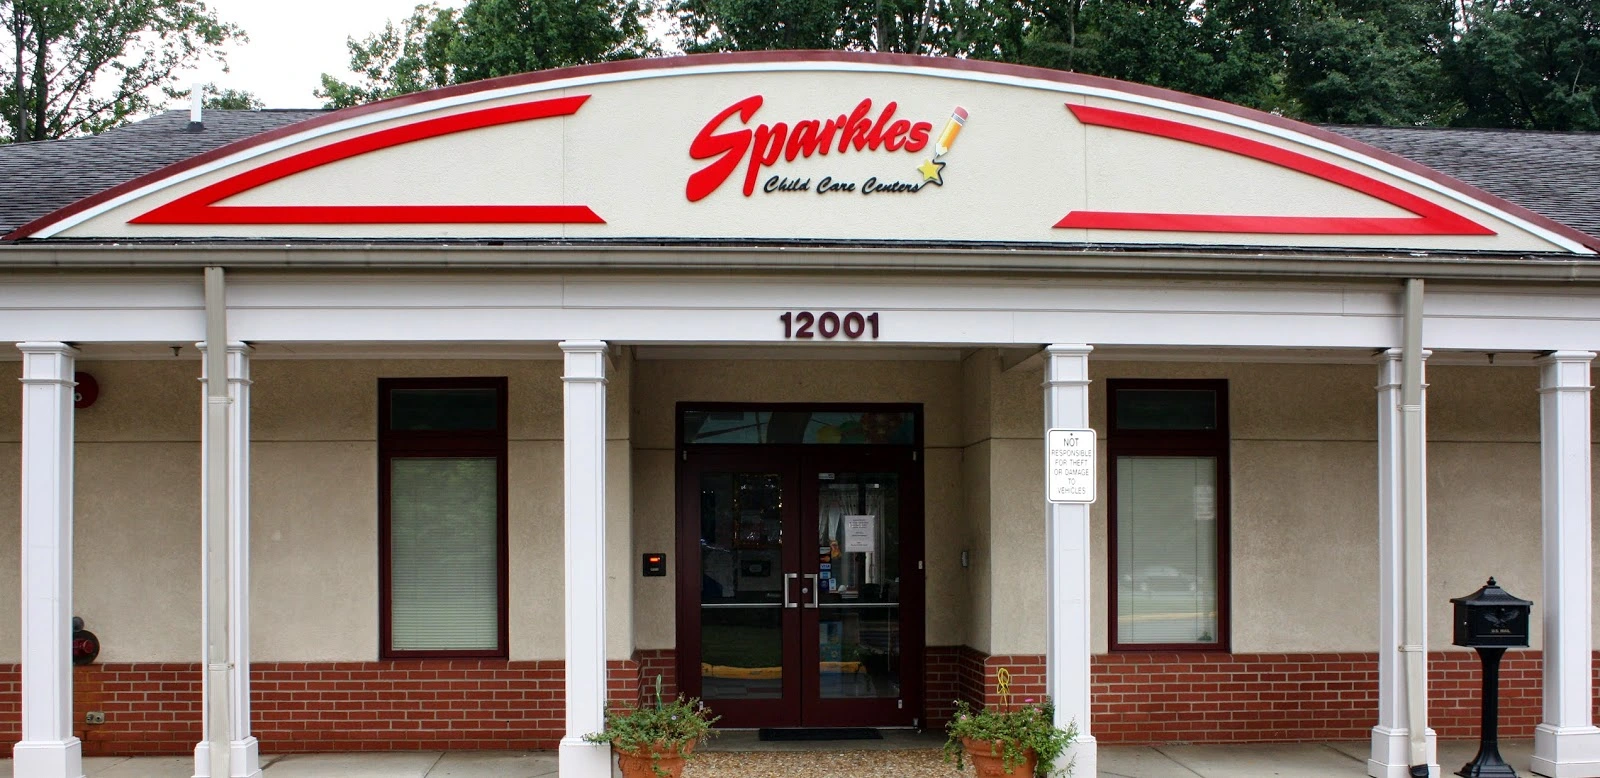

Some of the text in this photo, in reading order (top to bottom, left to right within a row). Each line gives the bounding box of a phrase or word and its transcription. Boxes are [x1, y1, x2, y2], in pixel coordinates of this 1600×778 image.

[686, 95, 932, 202] Sparkles
[763, 175, 920, 195] Child Care Centers
[780, 311, 879, 339] 12001
[1063, 437, 1079, 447] NOT
[1051, 449, 1092, 457] RESPONSIBLE
[1055, 459, 1088, 467] FOR THEFT
[1054, 468, 1089, 476] OR DAMAGE
[1068, 477, 1076, 486] TO
[1058, 486, 1086, 495] VEHICLES
